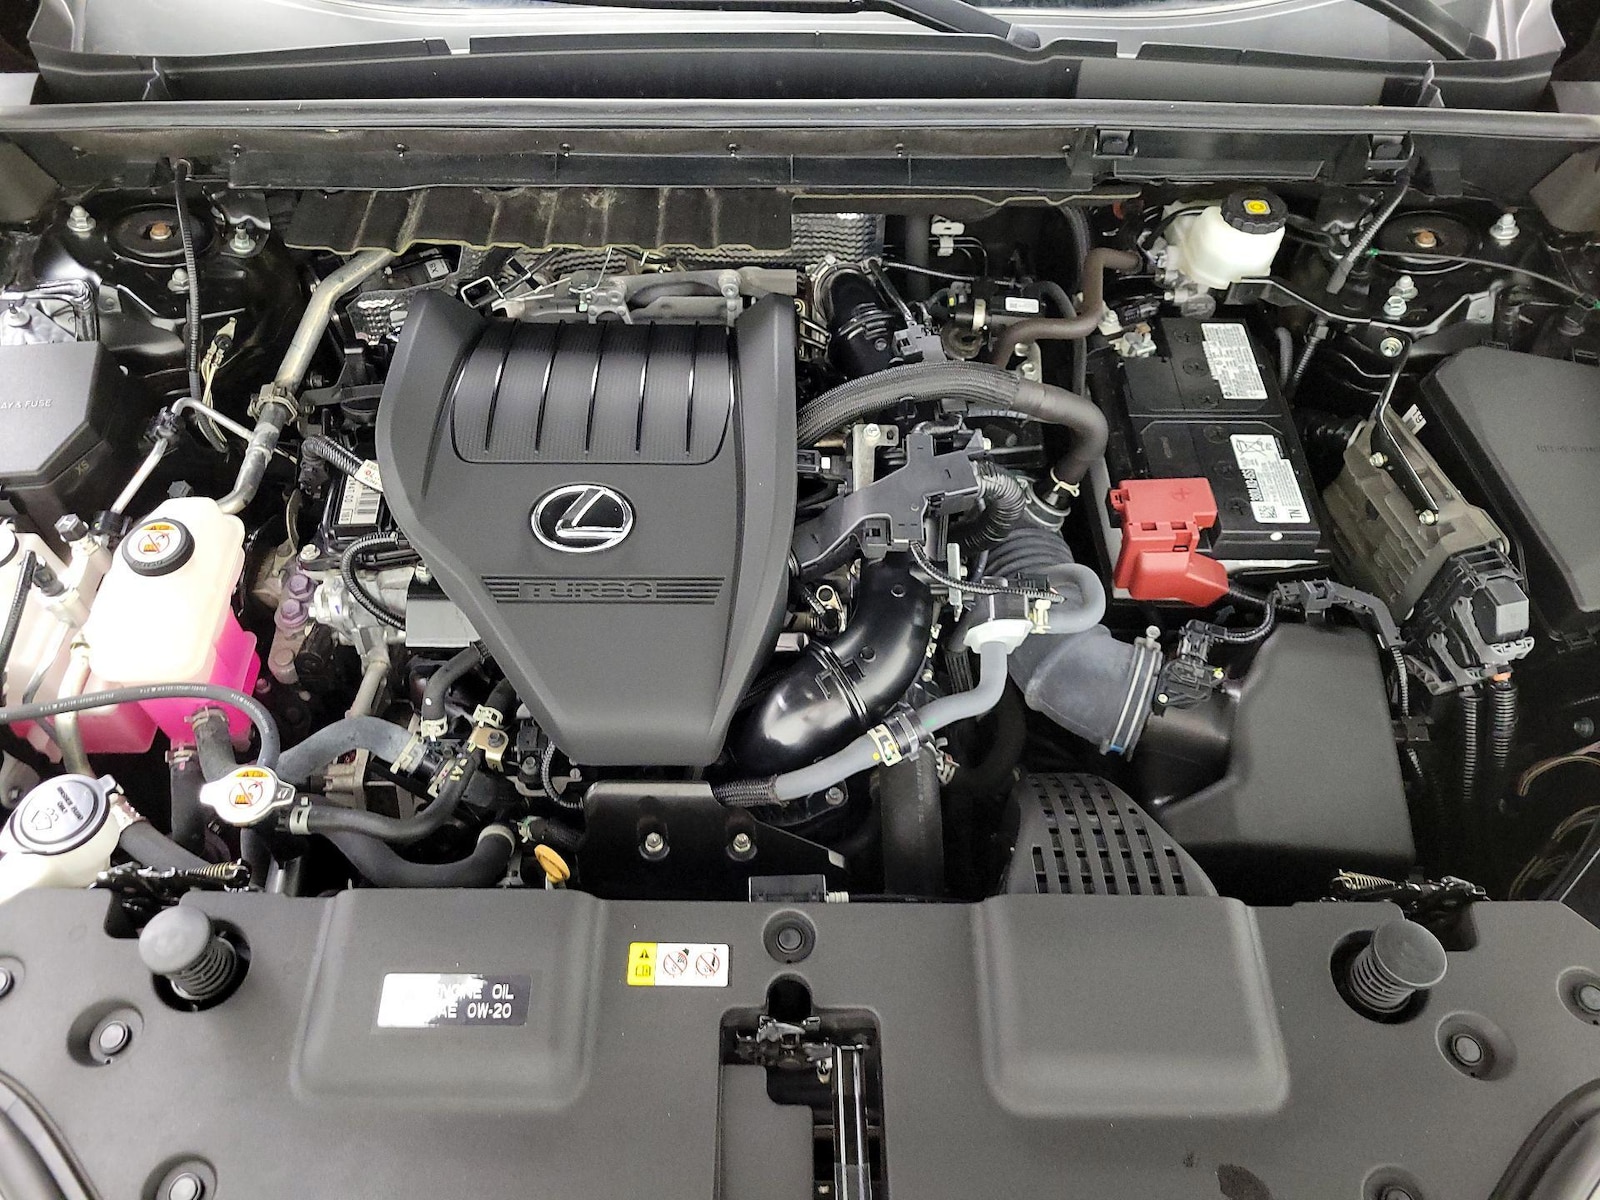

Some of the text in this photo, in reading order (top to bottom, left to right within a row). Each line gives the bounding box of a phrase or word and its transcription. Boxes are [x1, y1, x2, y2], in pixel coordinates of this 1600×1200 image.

[24, 399, 53, 409] FUSE
[523, 582, 653, 598] TURBO
[491, 983, 515, 1000] OIL
[467, 1002, 512, 1019] 0W-20
